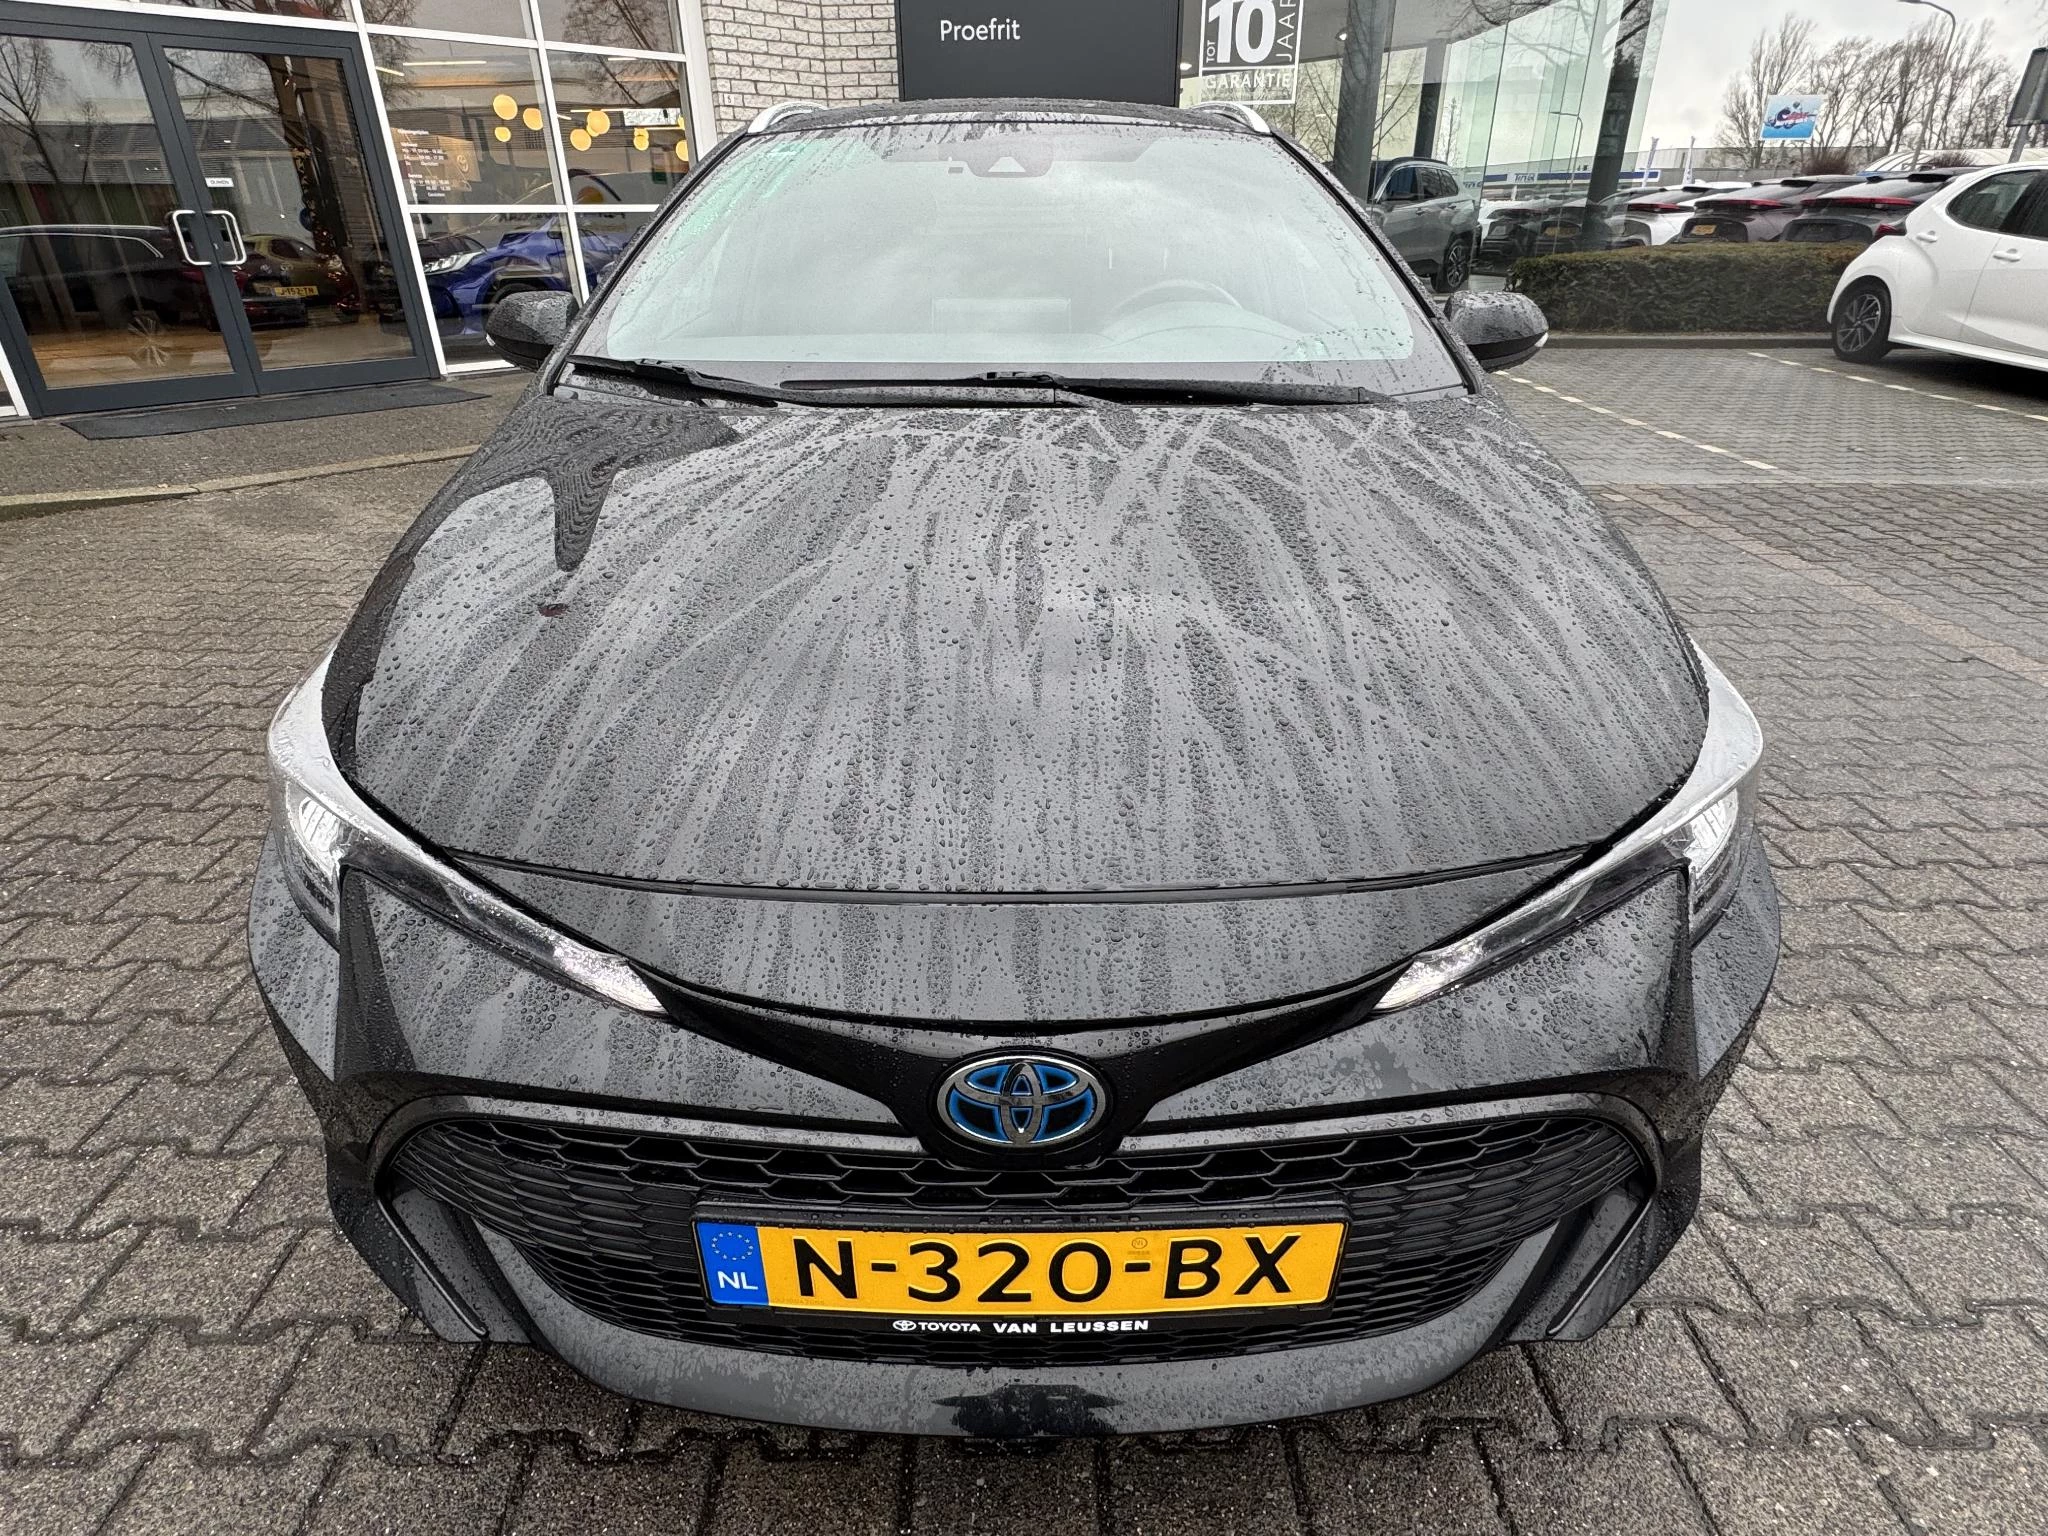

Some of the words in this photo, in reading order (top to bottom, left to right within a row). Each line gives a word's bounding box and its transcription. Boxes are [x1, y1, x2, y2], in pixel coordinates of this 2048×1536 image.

[940, 17, 1021, 41] Proefrit
[1208, 0, 1276, 63] 10
[1206, 40, 1216, 63] TOT
[1206, 72, 1292, 89] GARANTIE
[793, 1234, 1301, 1304] N-320-BX
[716, 1271, 758, 1291] NL
[918, 1321, 981, 1333] TOYOTA
[993, 1322, 1037, 1334] VAN
[1050, 1319, 1149, 1333] LEUSSEN
